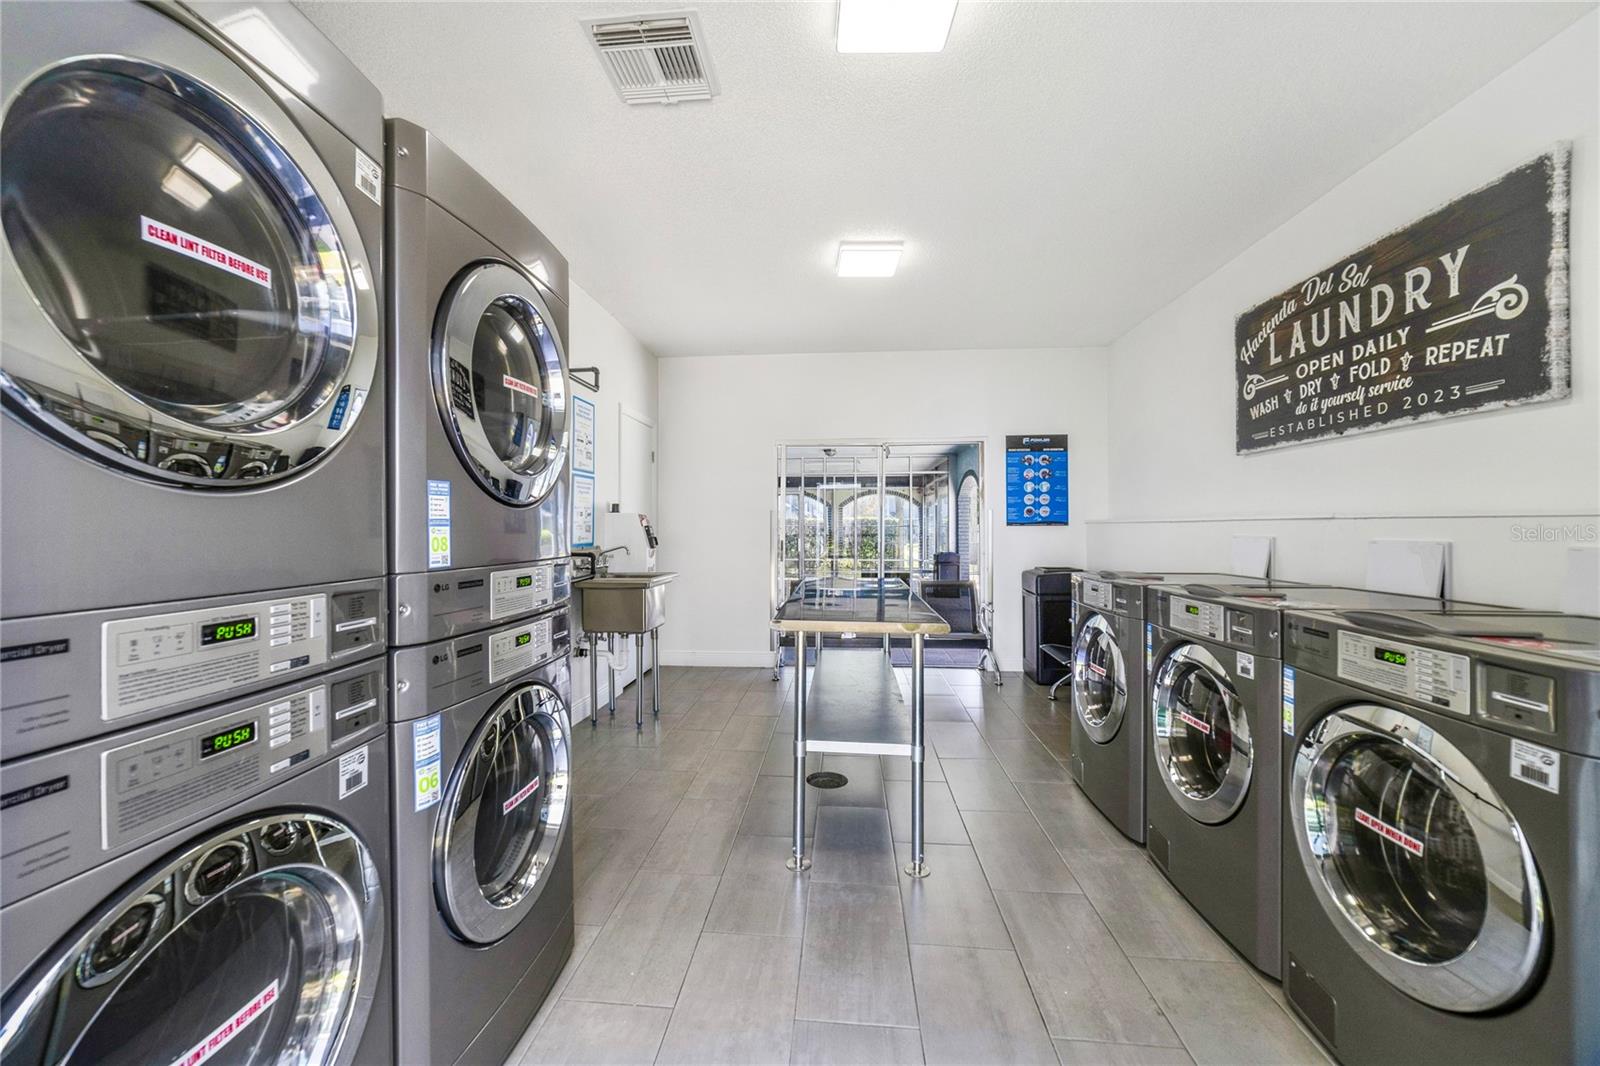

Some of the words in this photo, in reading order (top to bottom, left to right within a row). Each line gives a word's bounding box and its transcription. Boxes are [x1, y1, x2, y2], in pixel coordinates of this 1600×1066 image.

[147, 224, 178, 245] CLEAN
[180, 237, 199, 254] LINT
[201, 245, 227, 265] FILTER
[228, 257, 255, 277] BEFORE
[255, 268, 269, 282] USE
[1240, 298, 1298, 365] Hacienda
[1301, 272, 1335, 306] Del
[1338, 262, 1373, 293] Sol
[1268, 244, 1471, 366] LAUNDRY
[1249, 395, 1279, 420] WASH
[1299, 377, 1323, 400] DRY
[1349, 356, 1391, 383] FOLD
[1425, 333, 1511, 366] REPEAT
[1296, 349, 1345, 379] OPEN
[1352, 326, 1411, 361] DAILY
[1269, 401, 1389, 437] ESTABLISHED
[1402, 385, 1461, 410] 2023
[1295, 401, 1308, 415] do
[1310, 397, 1319, 412] it
[1320, 385, 1366, 414] yourself
[1367, 374, 1414, 398] service
[431, 536, 449, 553] 08
[215, 623, 252, 640] PUSH
[1384, 651, 1408, 665] PUSH
[214, 728, 250, 750] PUSH
[418, 772, 439, 794] 06
[208, 1023, 233, 1051] FILTER
[235, 999, 262, 1029] BEFORE
[263, 987, 275, 1005] USE
